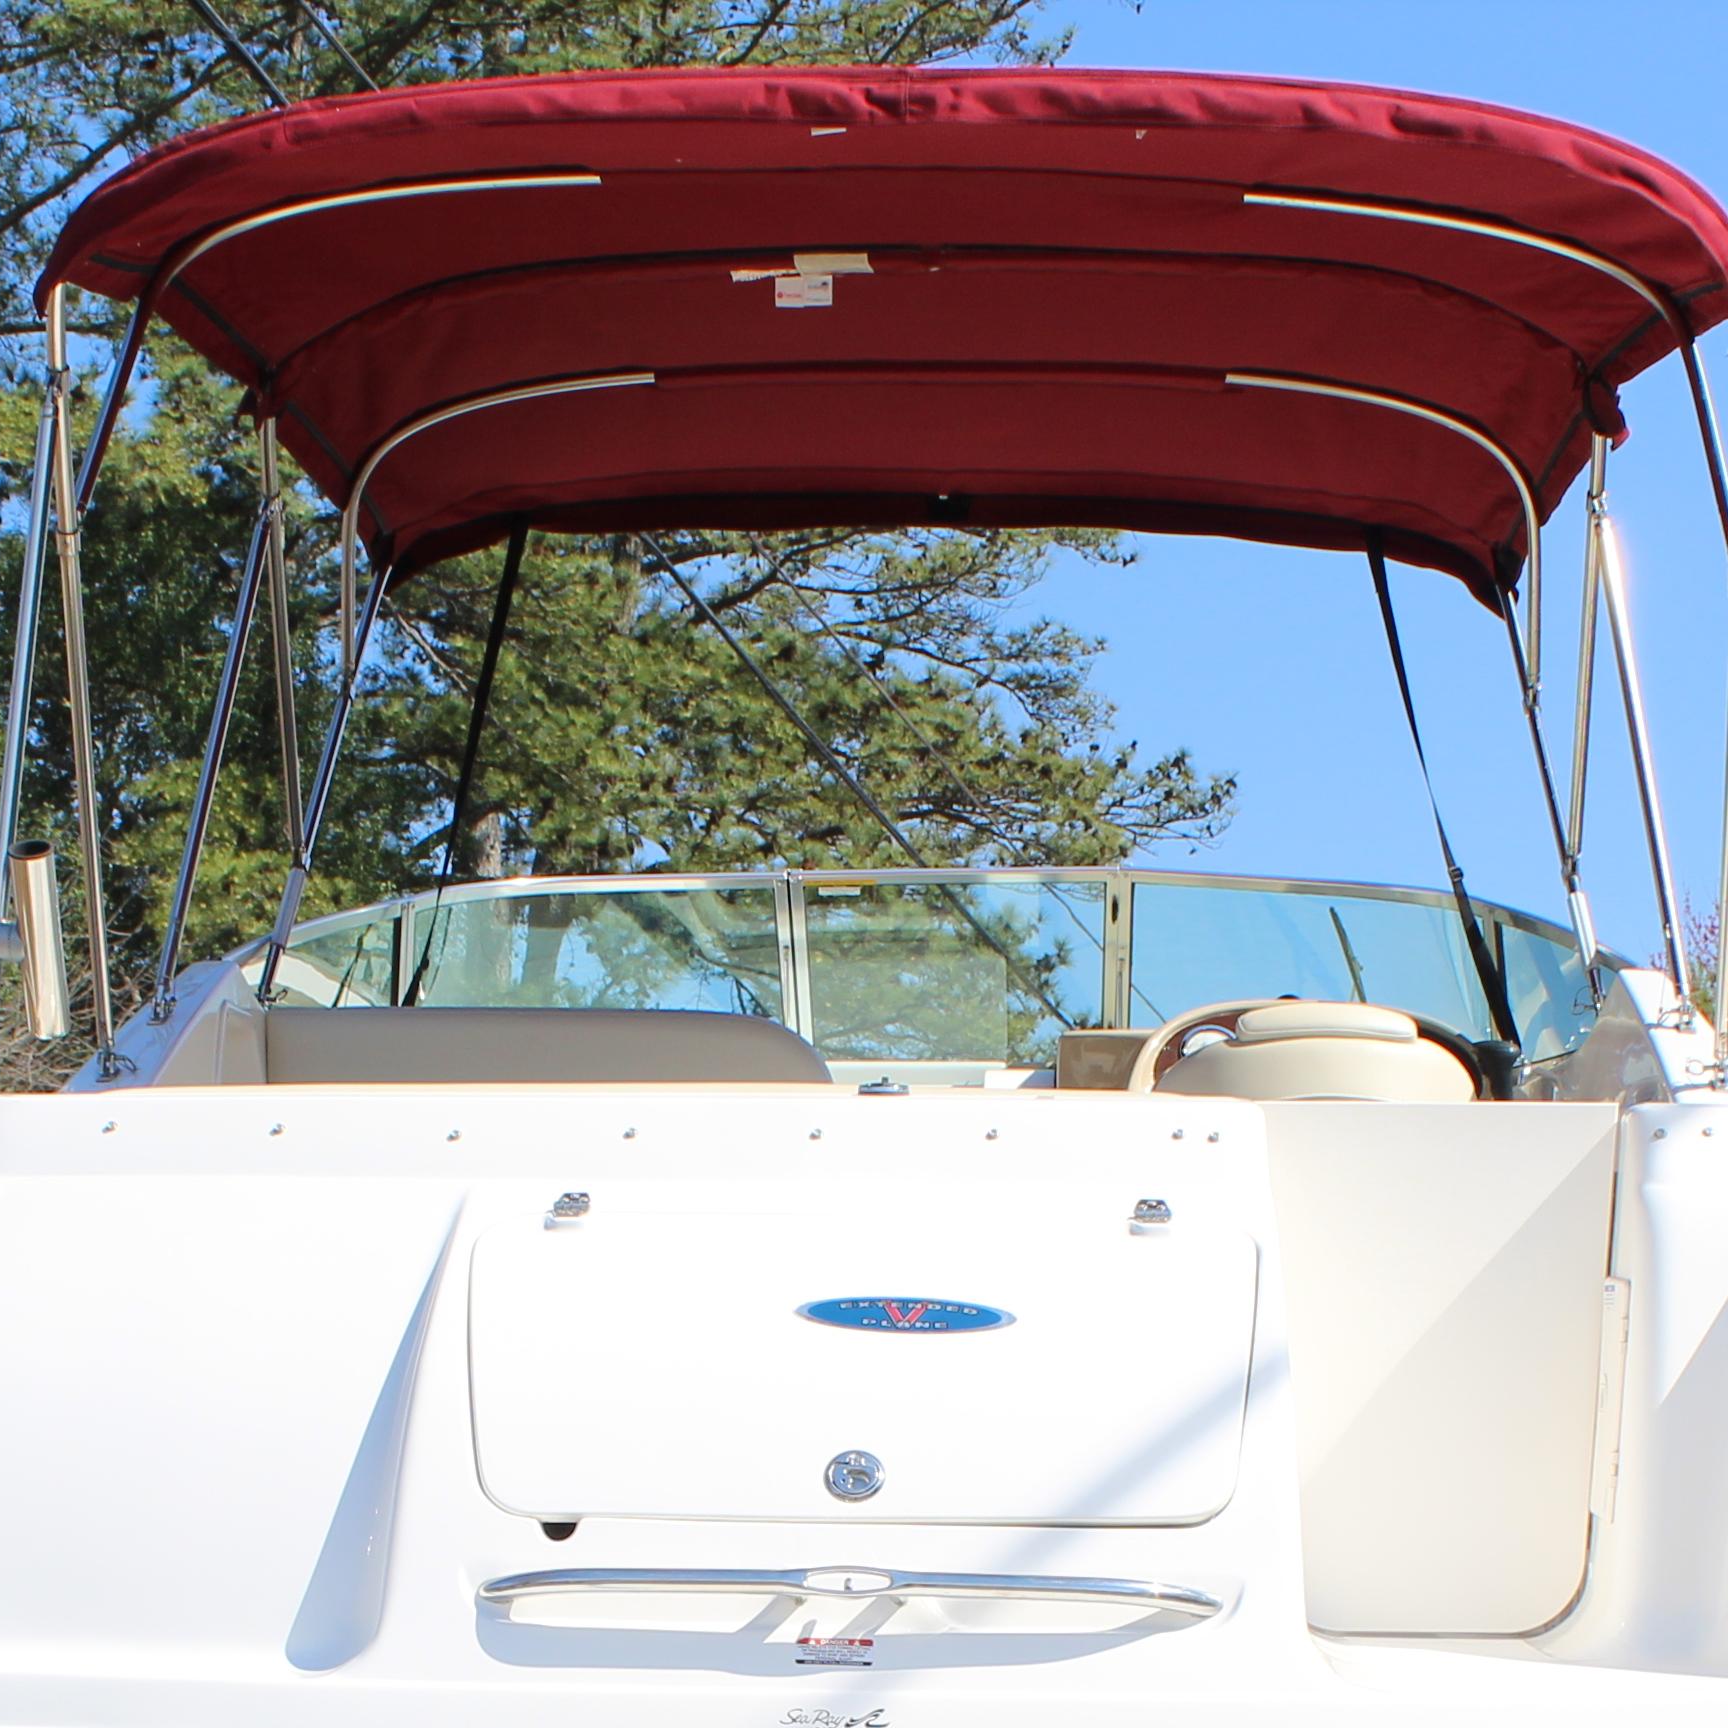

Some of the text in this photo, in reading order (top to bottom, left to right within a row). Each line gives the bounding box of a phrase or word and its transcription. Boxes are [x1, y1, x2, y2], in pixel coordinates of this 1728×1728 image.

[839, 1301, 978, 1315] EXTENDED
[861, 1318, 948, 1329] PLANE
[779, 1708, 845, 1728] Sea Ray
